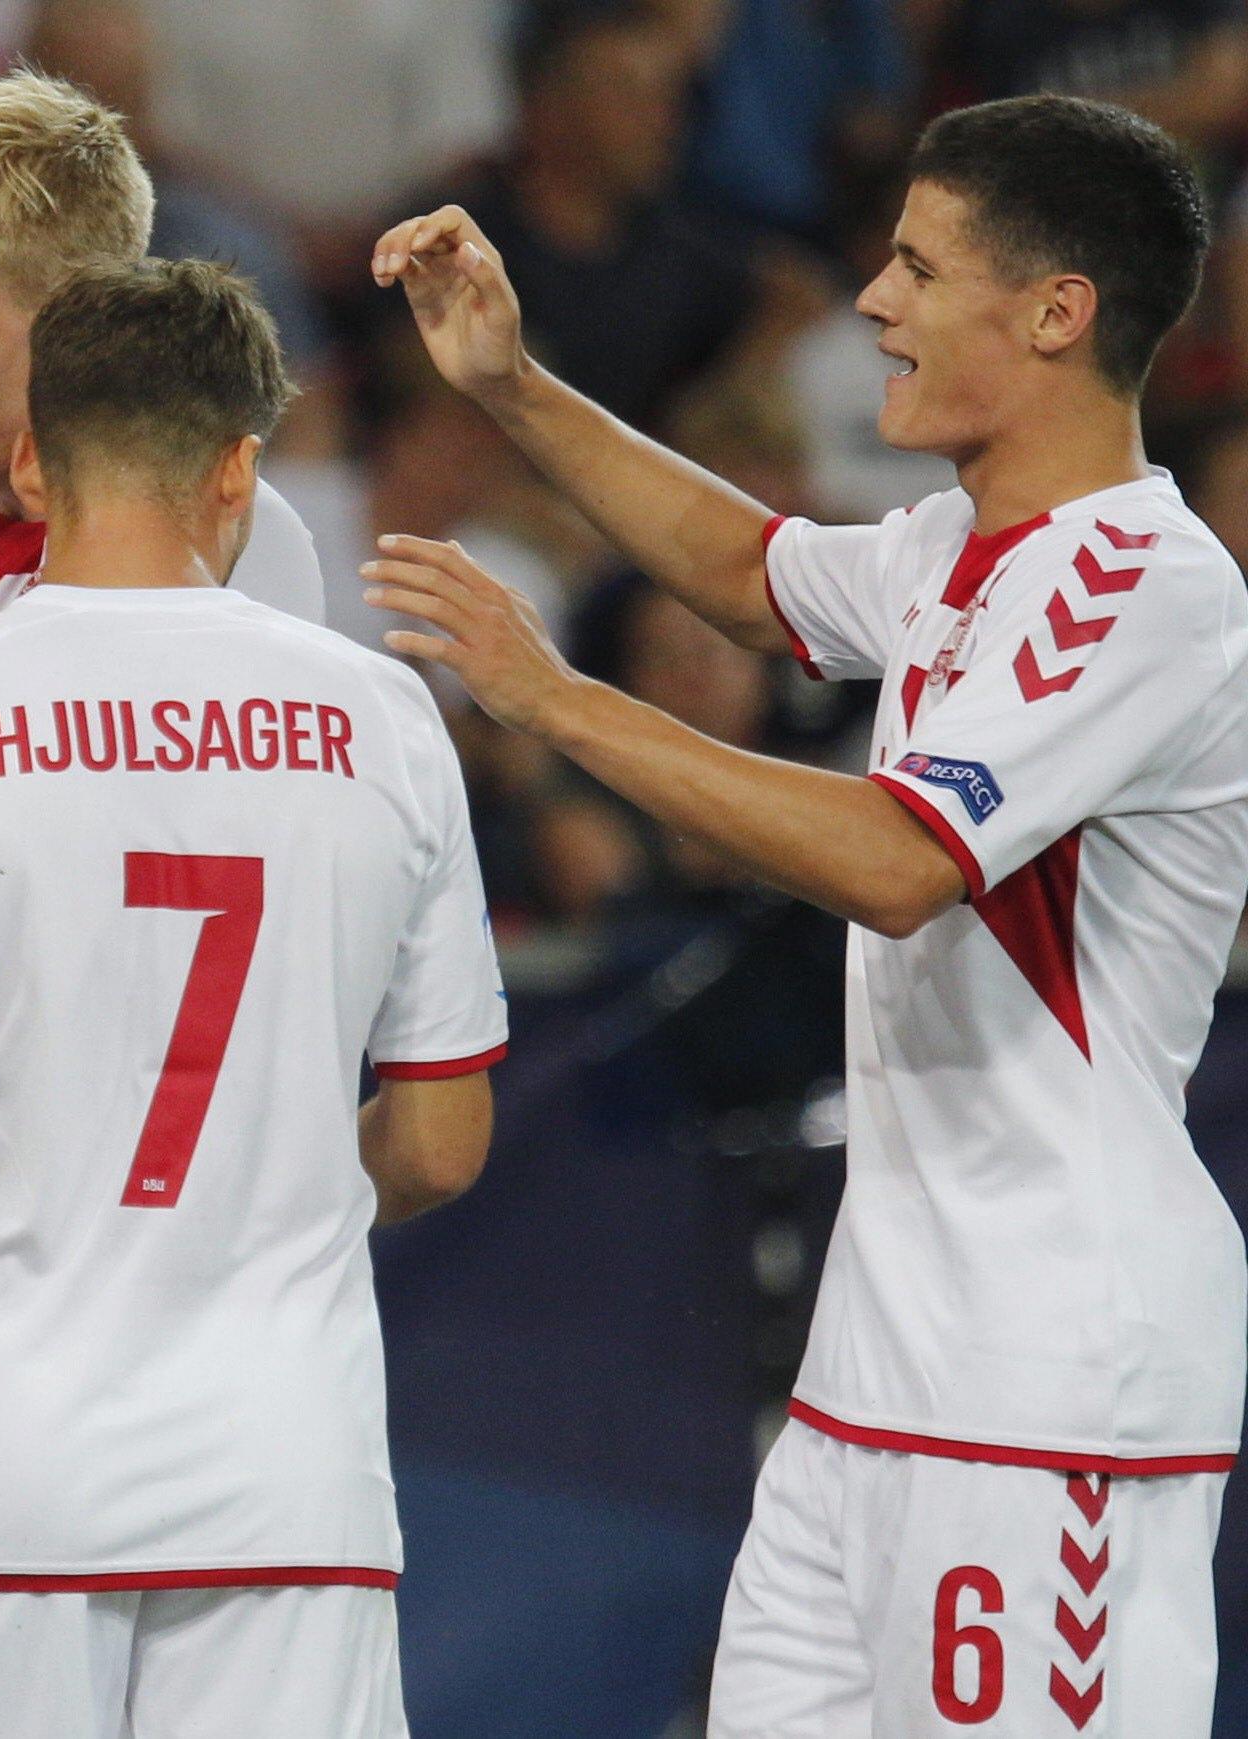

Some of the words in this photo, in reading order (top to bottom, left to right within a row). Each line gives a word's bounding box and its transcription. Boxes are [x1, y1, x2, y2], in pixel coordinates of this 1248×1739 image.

[925, 763, 997, 814] RESPECT
[119, 850, 265, 1209] 7
[932, 1565, 1005, 1725] 6
